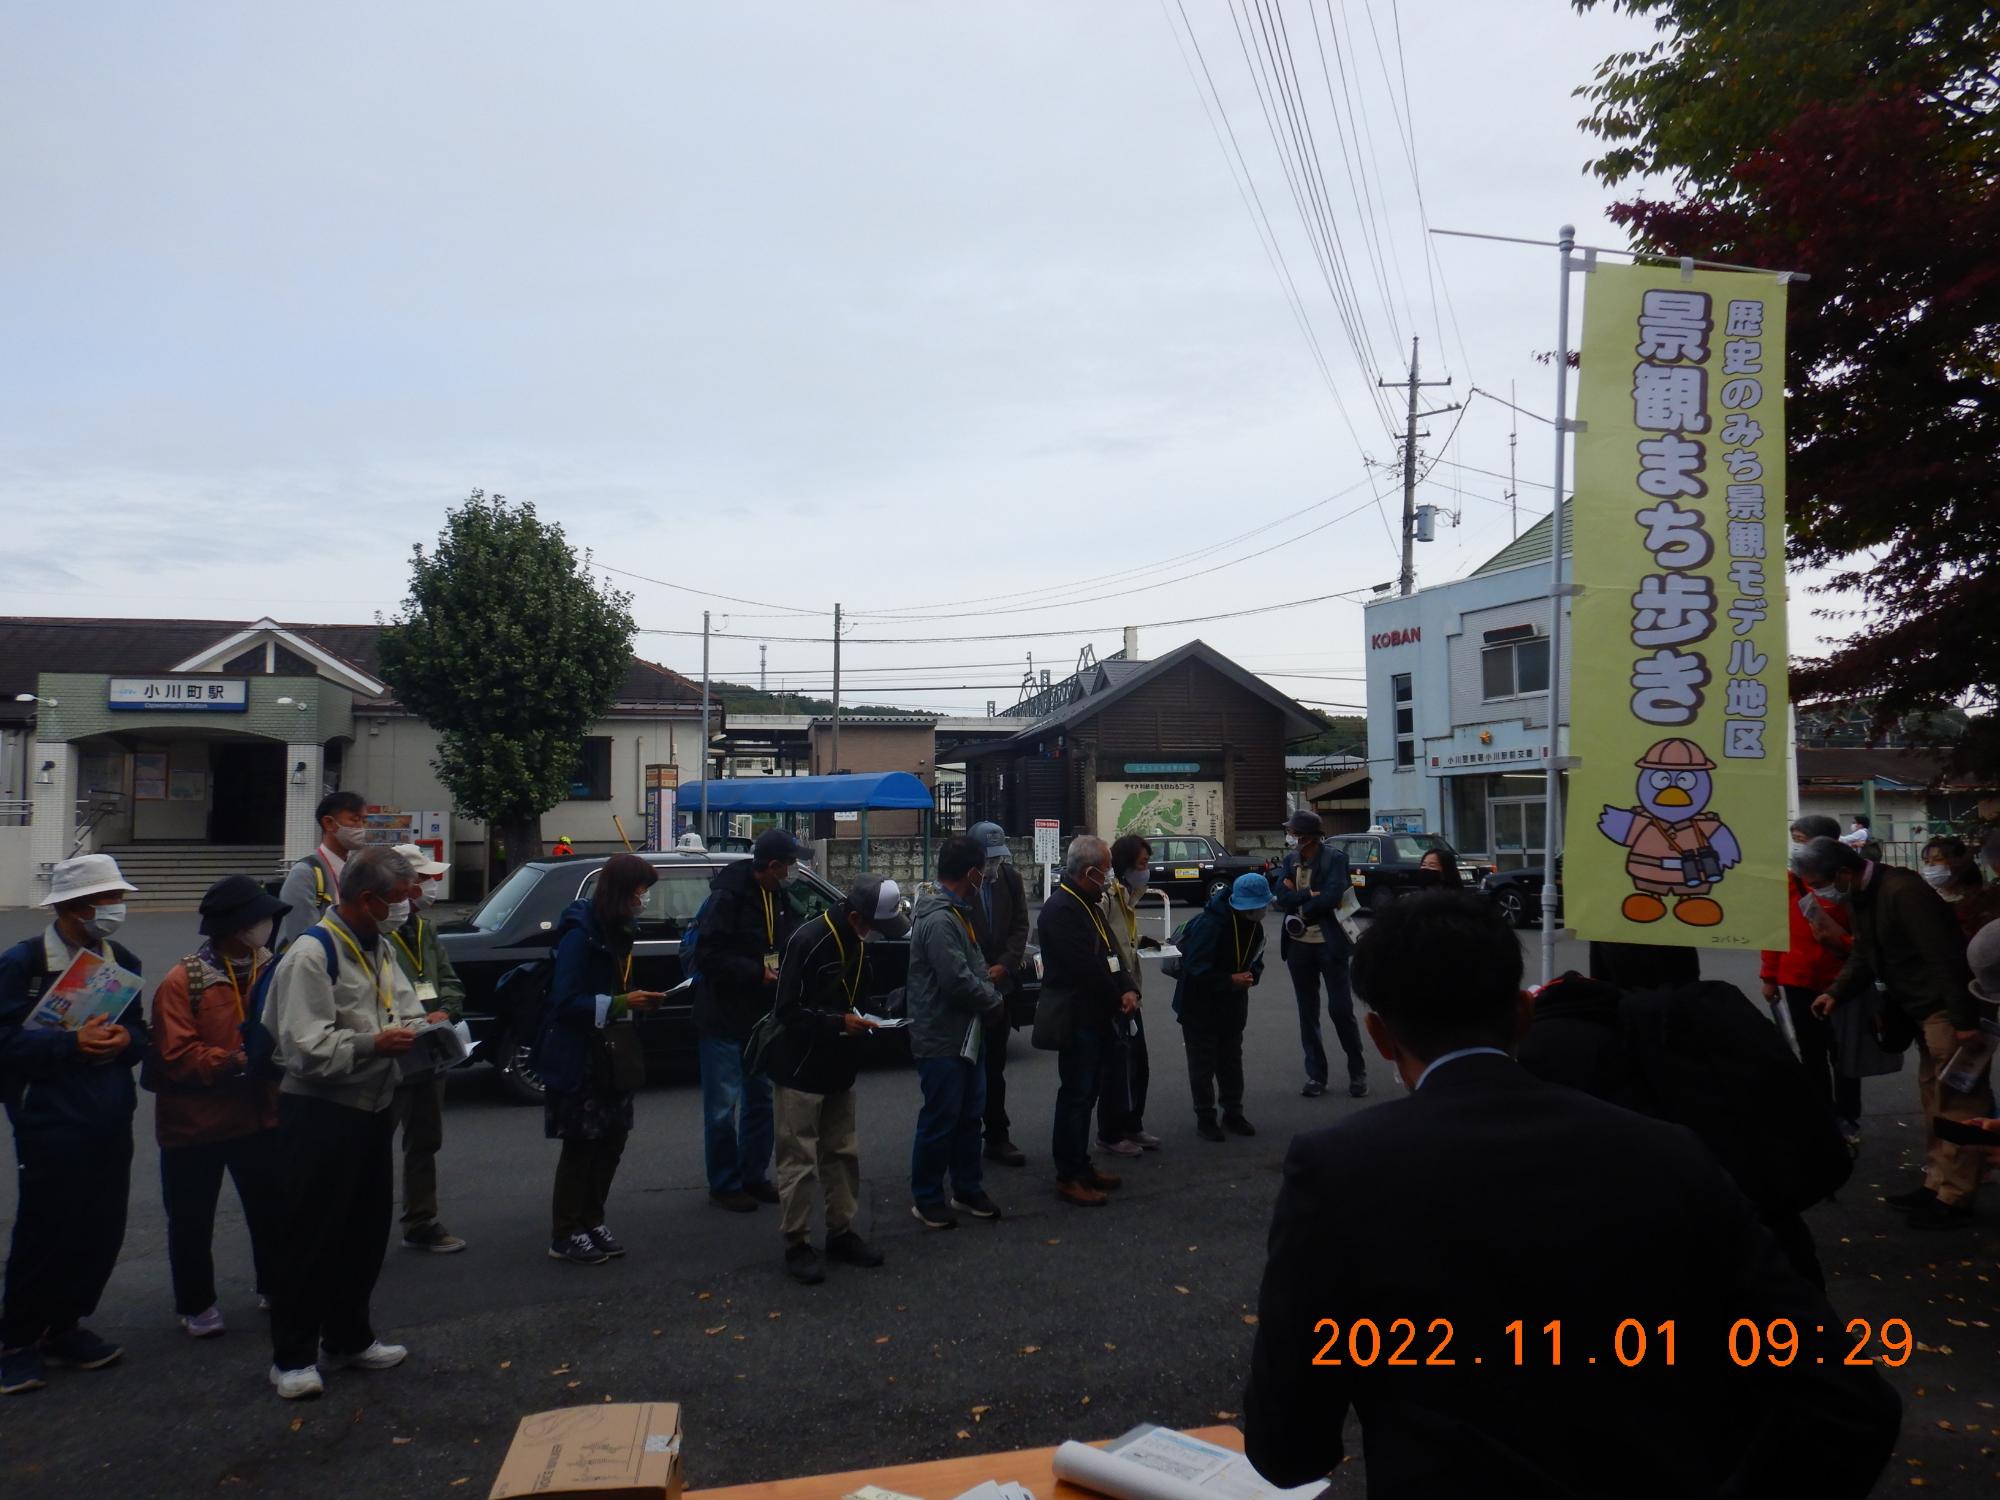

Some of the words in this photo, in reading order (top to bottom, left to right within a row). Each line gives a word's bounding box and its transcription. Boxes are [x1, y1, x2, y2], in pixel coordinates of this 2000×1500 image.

[1631, 289, 1717, 726] 景観まち歩き
[1720, 300, 1768, 759] 歴史のみち景観モデル地区
[144, 684, 224, 699] 小川町駅
[1372, 627, 1421, 650] KOBAN
